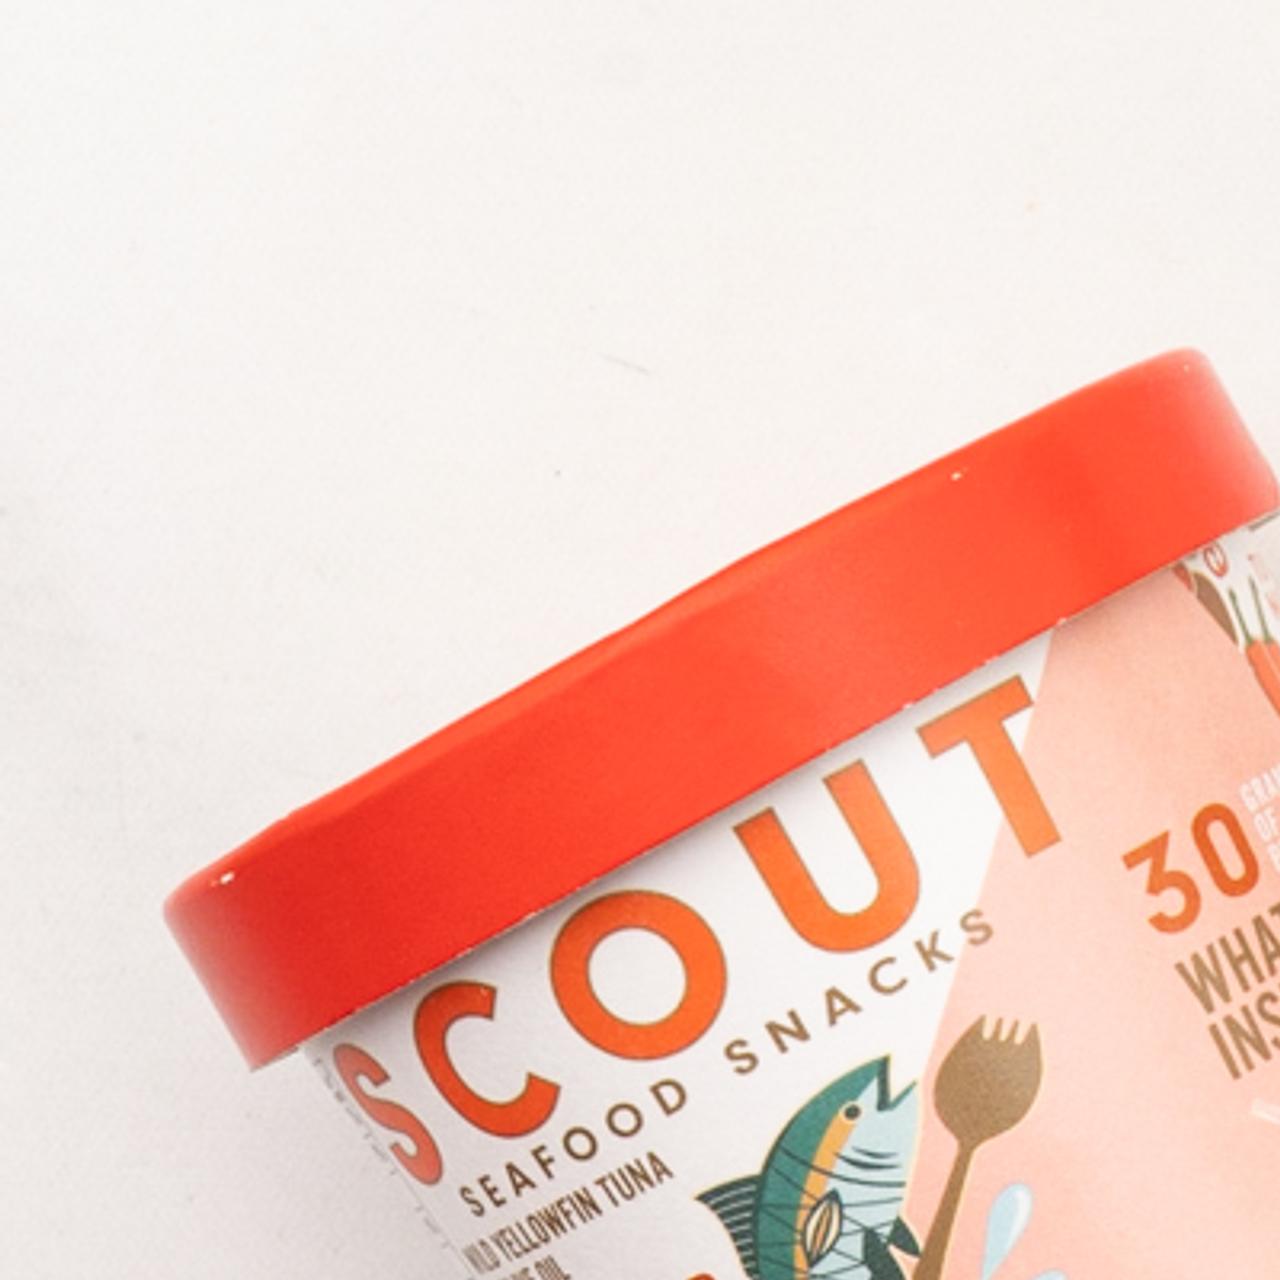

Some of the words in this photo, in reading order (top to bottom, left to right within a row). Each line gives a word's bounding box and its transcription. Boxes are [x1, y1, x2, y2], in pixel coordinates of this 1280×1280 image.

[1121, 802, 1260, 935] 30
[1254, 807, 1279, 843] OF
[333, 674, 1062, 1186] SCOUT
[459, 1077, 688, 1218] SEAFOOD
[723, 908, 994, 1075] SNACKS
[491, 1186, 604, 1263] YELLOWFIN
[594, 1150, 674, 1208] TUNA
